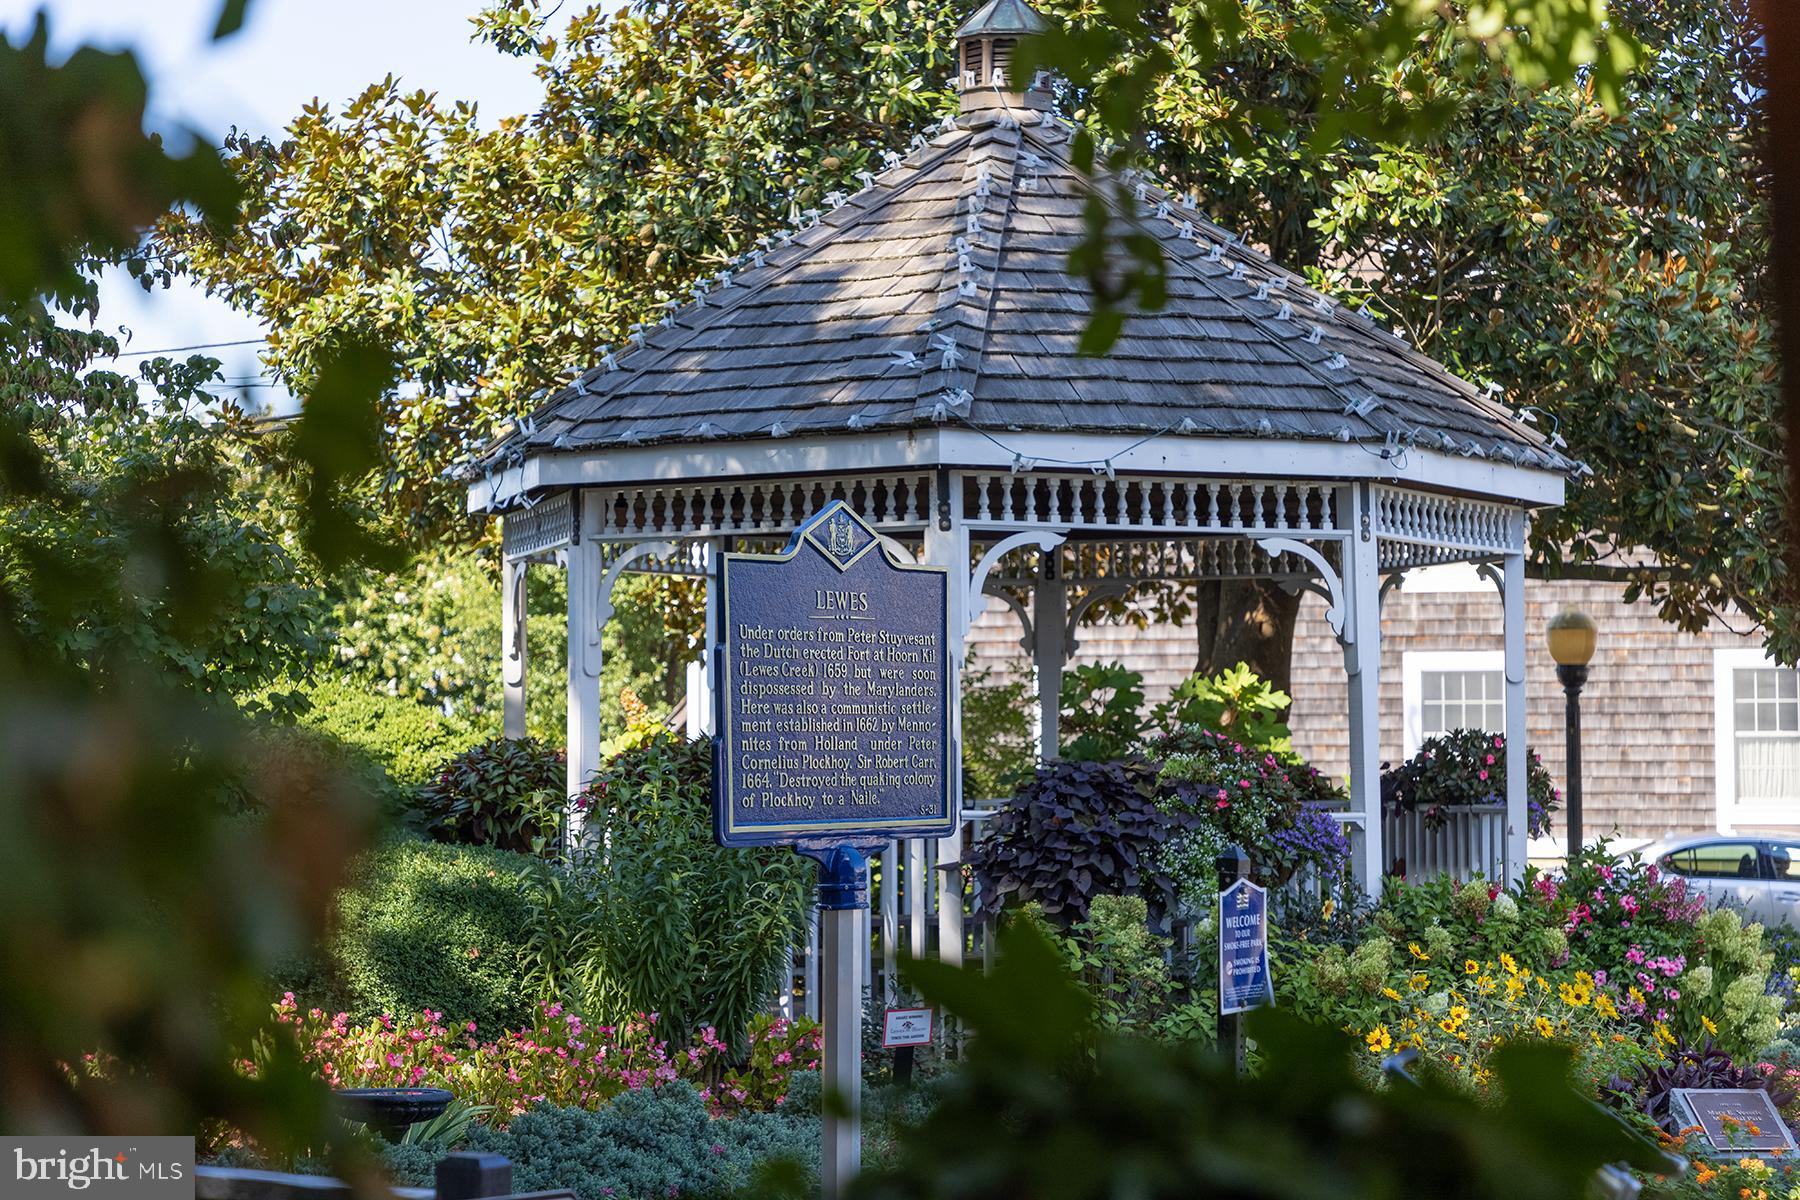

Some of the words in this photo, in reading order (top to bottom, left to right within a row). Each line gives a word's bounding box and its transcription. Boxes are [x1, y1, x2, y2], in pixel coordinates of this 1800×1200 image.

[815, 590, 868, 611] LEWES
[739, 624, 773, 640] Under
[778, 626, 814, 641] orders
[817, 626, 844, 642] from
[847, 628, 876, 644] Peter
[879, 630, 936, 647] Stuyvesant
[740, 643, 760, 658] the
[763, 643, 799, 659] Dutch
[802, 646, 843, 660] erected
[847, 645, 870, 661] Fort
[873, 647, 884, 662] at
[887, 646, 919, 662] Hoorn
[922, 648, 936, 663] Kil
[740, 661, 779, 677] (Lewes
[781, 661, 818, 677] Creek)
[823, 663, 848, 678] 1659
[854, 664, 871, 679] but
[880, 668, 904, 680] were
[912, 669, 936, 681] soon
[740, 680, 814, 699] dispossessed
[822, 680, 836, 699] by
[843, 682, 861, 696] the
[867, 681, 937, 699] Marylanders.
[741, 698, 770, 714] Here
[773, 703, 794, 714] was
[796, 700, 818, 714] also
[821, 703, 827, 714] a
[831, 701, 897, 715] communistic
[901, 700, 937, 714] settle-
[741, 719, 771, 732] ment
[776, 717, 840, 732] established
[843, 718, 853, 732] in
[856, 717, 879, 732] 1662
[881, 718, 895, 734] by
[897, 716, 937, 732] Menno-
[741, 737, 772, 751] nites
[778, 736, 808, 751] from
[815, 735, 858, 751] Holland
[870, 736, 902, 750] under
[908, 735, 937, 750] Peter
[741, 754, 799, 770] Cornelius
[802, 754, 853, 771] Plockhoy.
[857, 754, 872, 769] Sir
[875, 754, 909, 769] Robert
[840, 772, 857, 787] the
[860, 772, 901, 790] quaking
[903, 771, 937, 788] colony
[742, 793, 756, 808] of
[762, 792, 816, 810] Plockhoy
[822, 792, 834, 806] to
[838, 794, 845, 806] a
[1225, 914, 1261, 929] WELCOME
[1241, 929, 1251, 937] OUR
